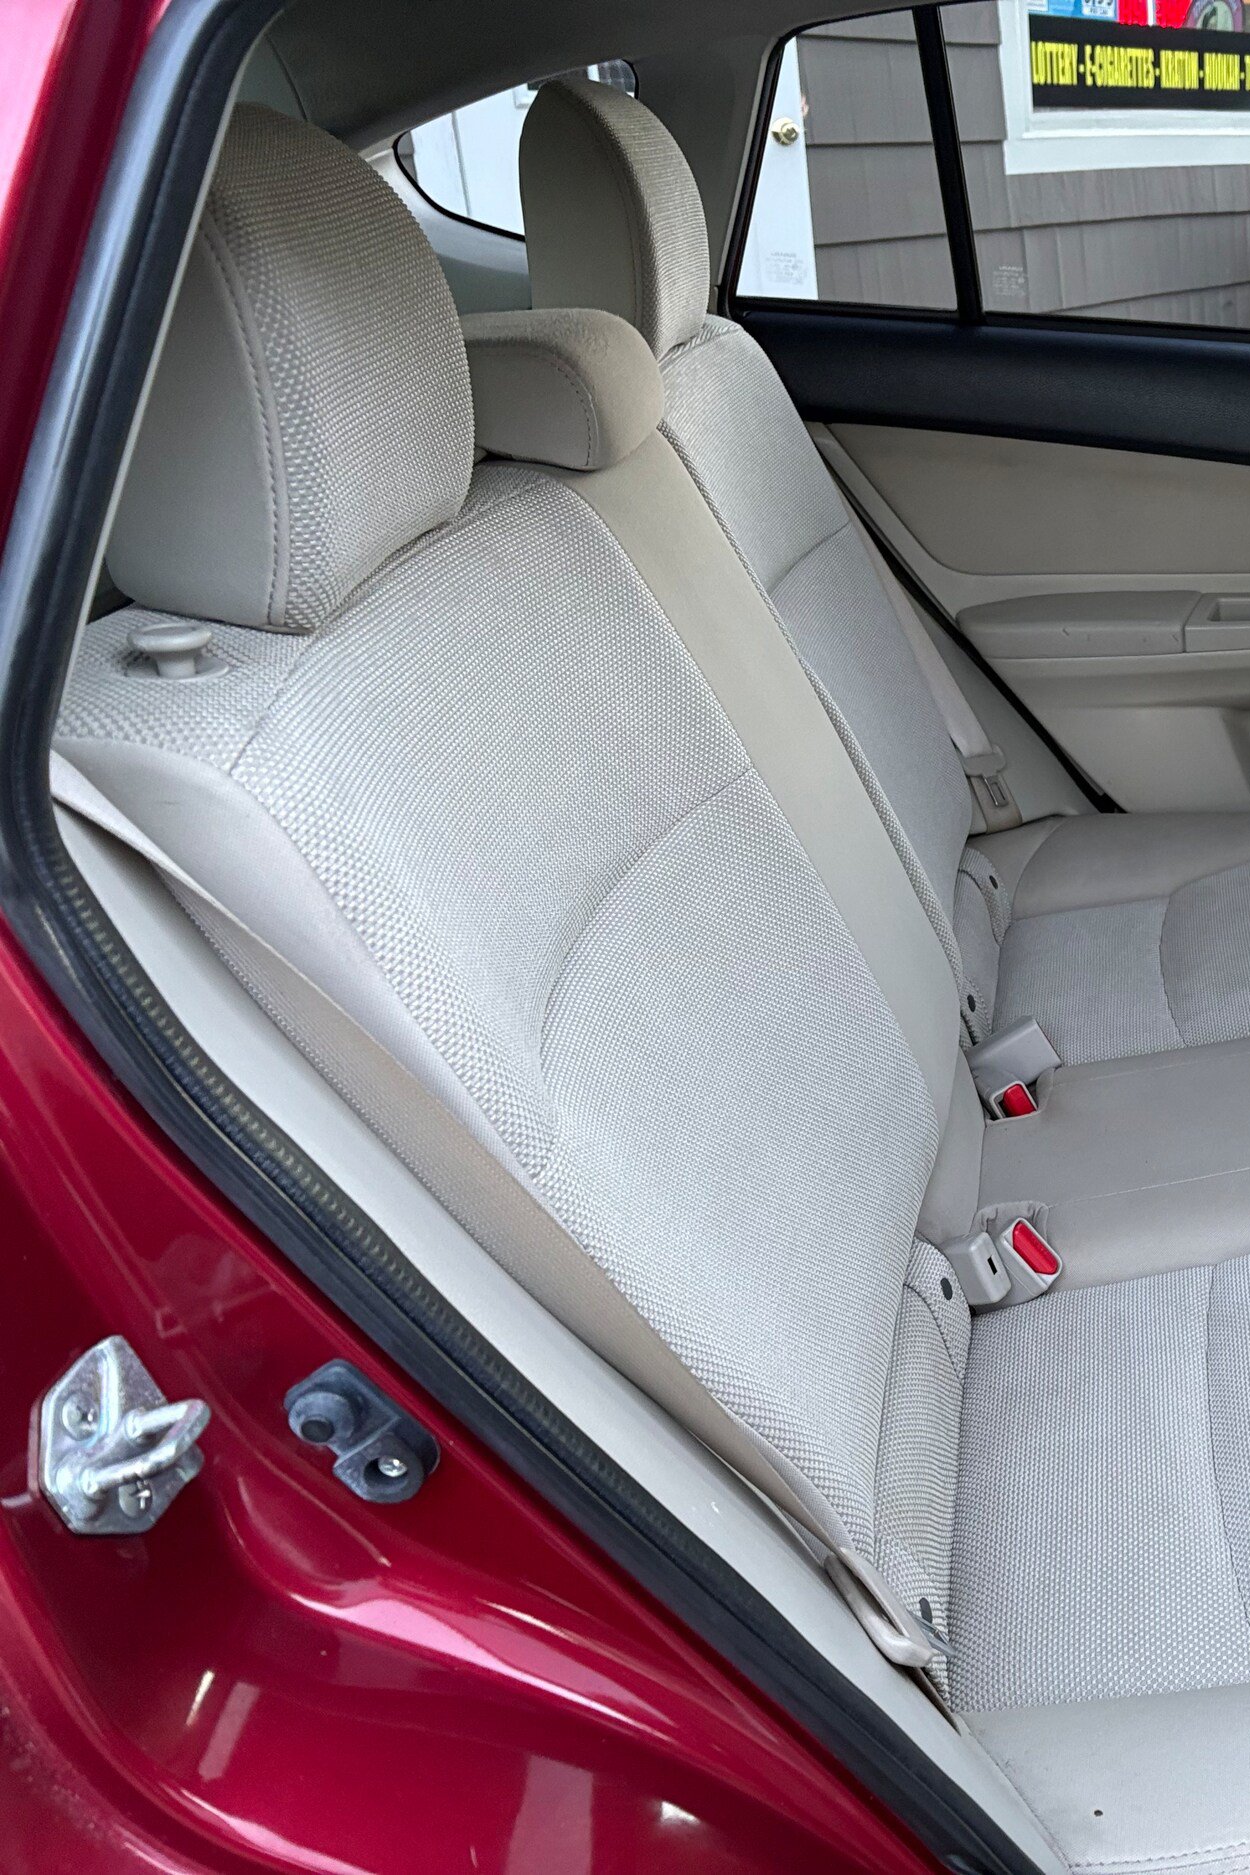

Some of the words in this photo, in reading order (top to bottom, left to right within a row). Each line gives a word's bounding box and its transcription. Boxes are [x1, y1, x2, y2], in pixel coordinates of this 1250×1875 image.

[1031, 41, 1078, 86] LOTTERY
[1084, 45, 1155, 89] E-CIGARETTES
[1203, 52, 1240, 91] HOOKAH
